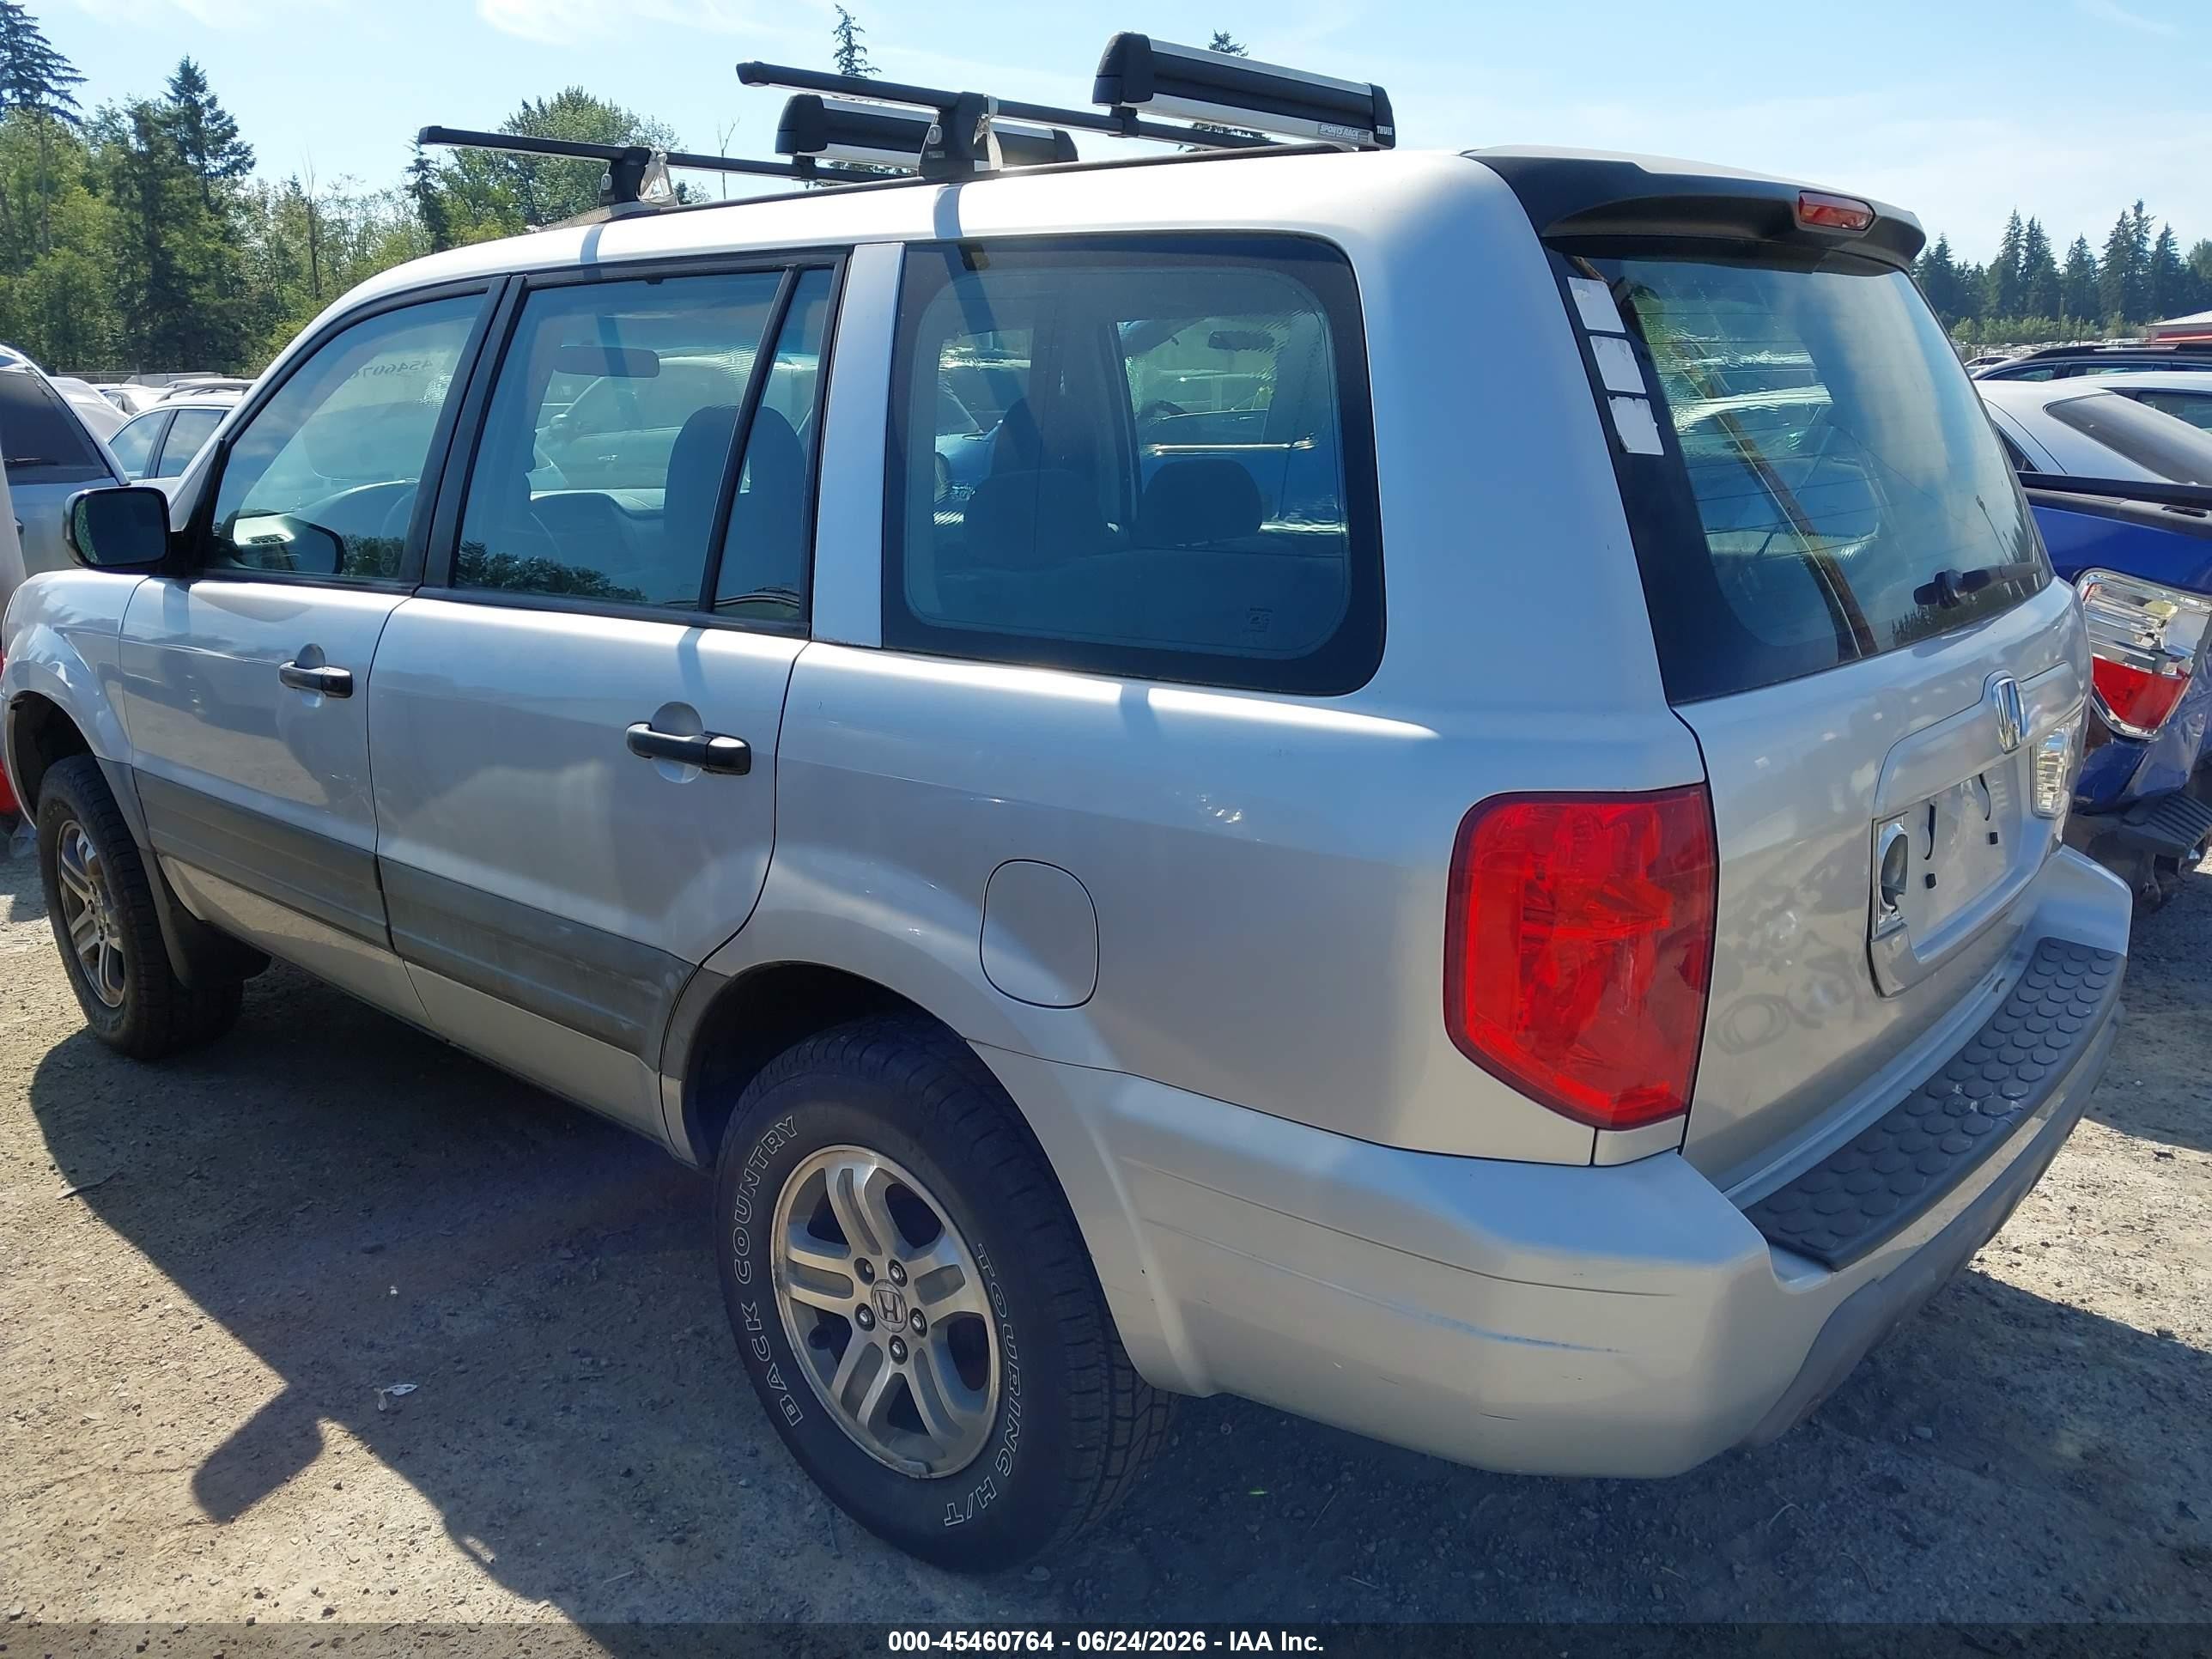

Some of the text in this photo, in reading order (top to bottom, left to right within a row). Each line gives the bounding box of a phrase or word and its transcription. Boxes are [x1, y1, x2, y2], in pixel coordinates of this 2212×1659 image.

[1376, 125, 1393, 136] THULE
[732, 1115, 803, 1426] BACK COUNTRY
[944, 1243, 1023, 1527] TOURING H/T
